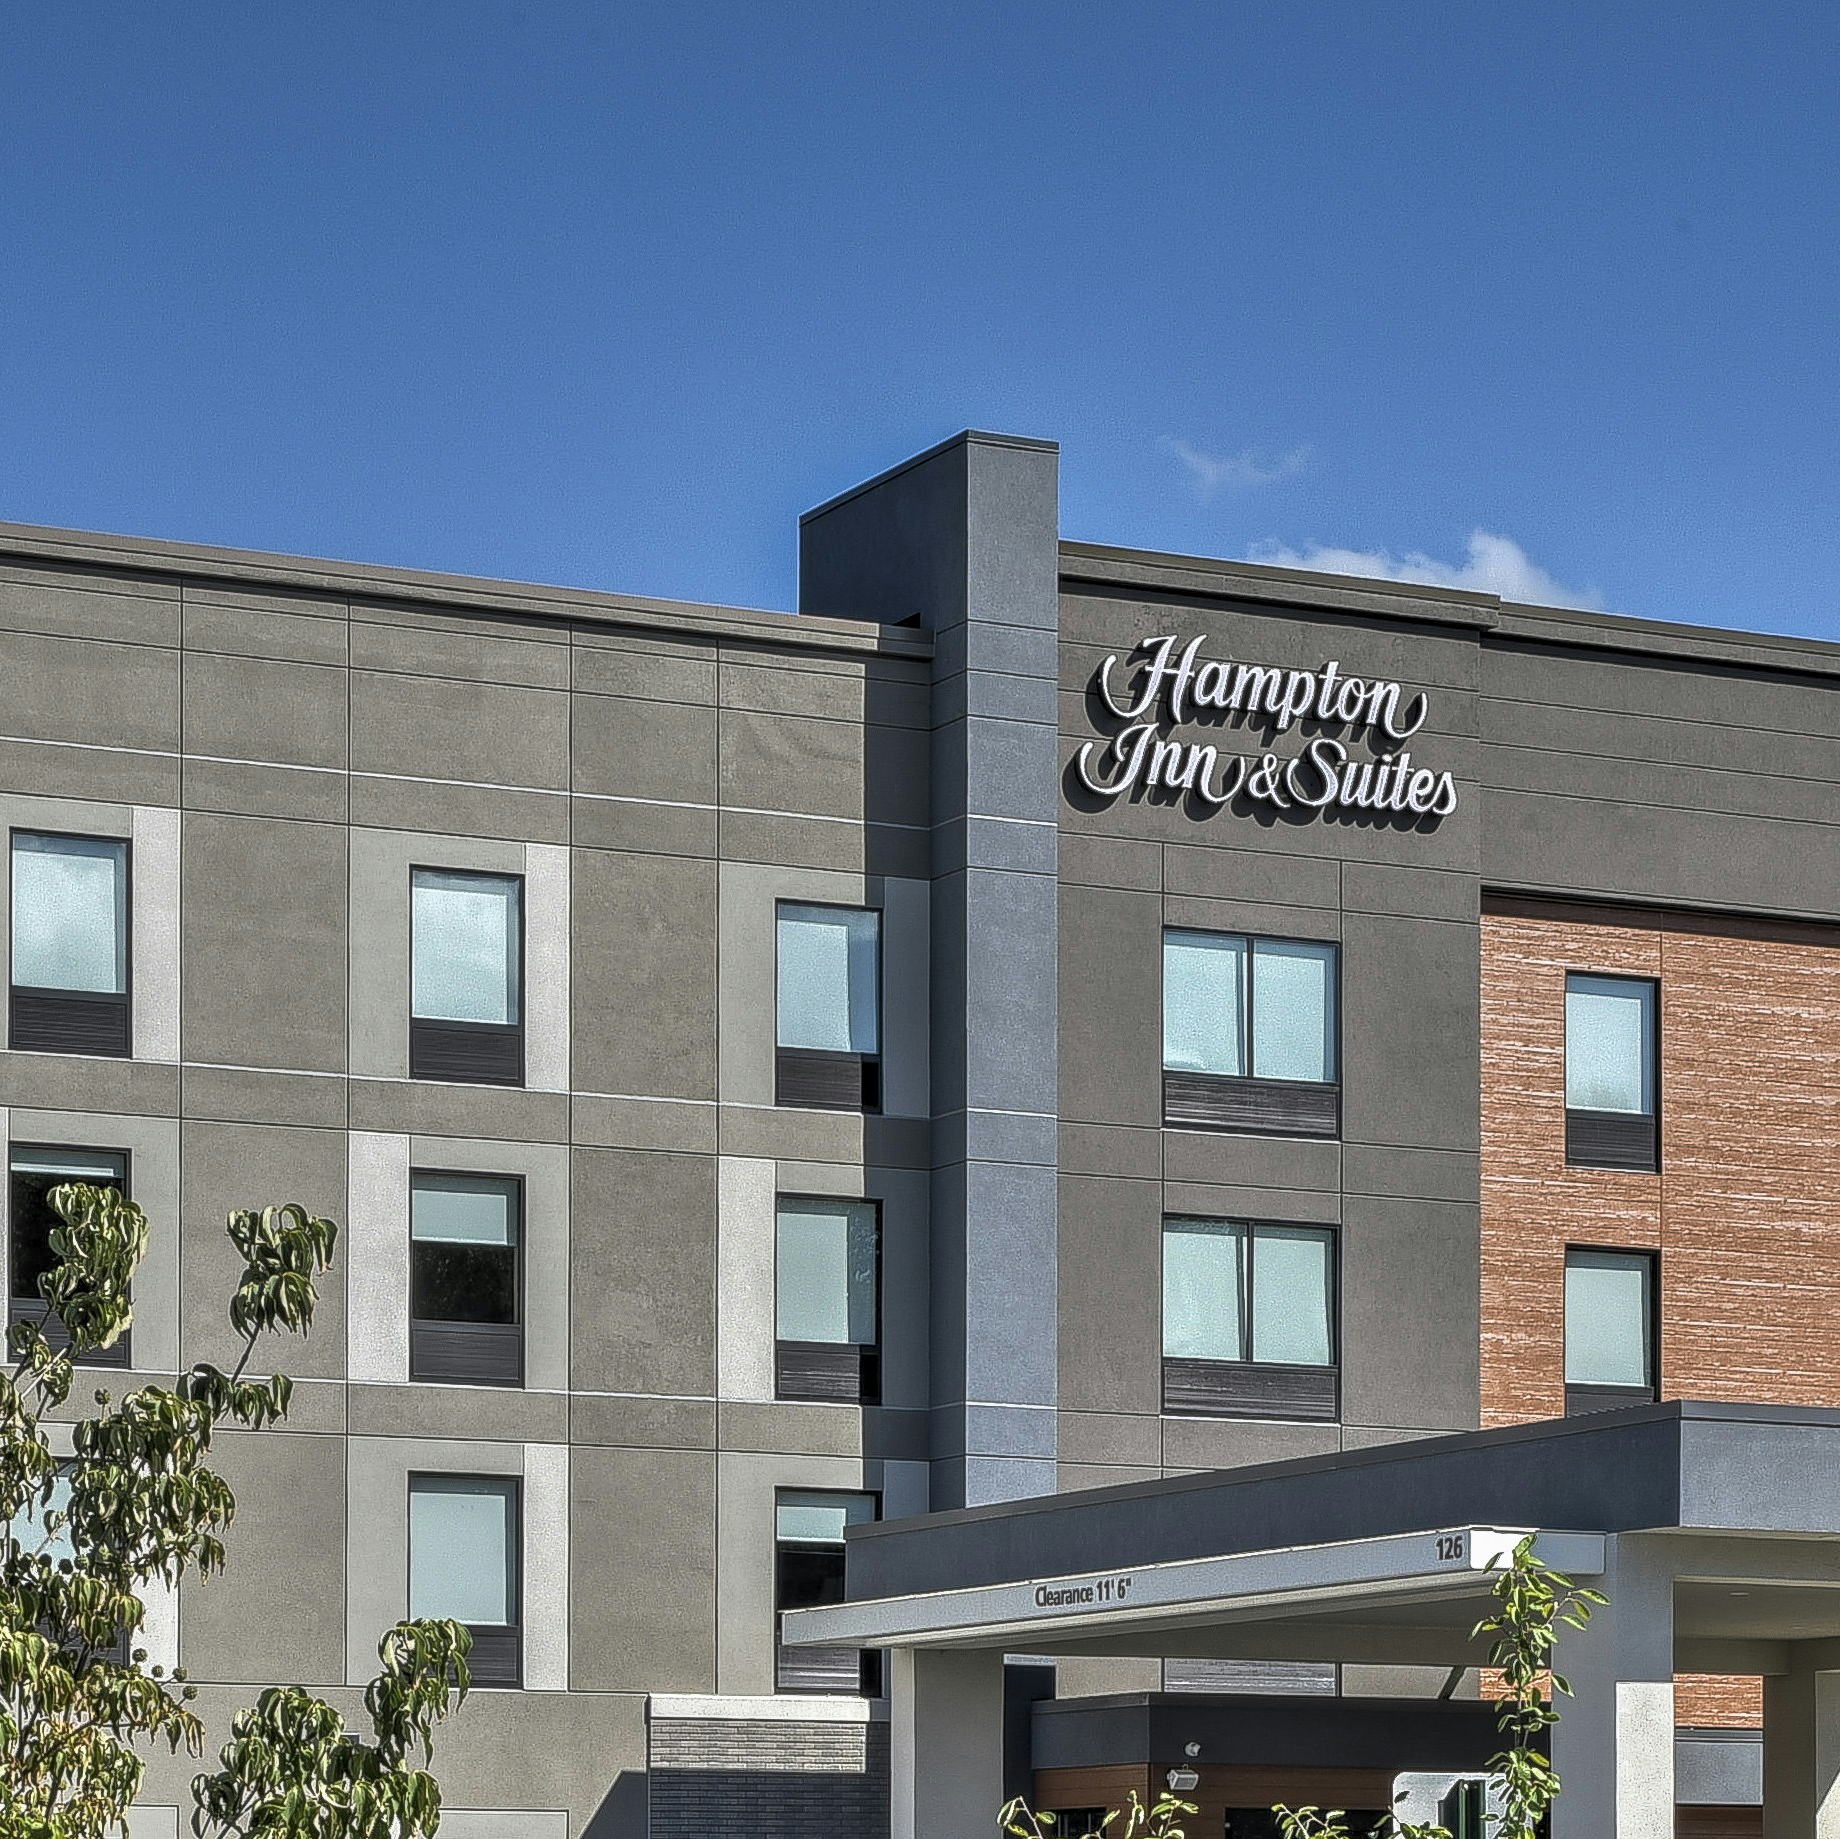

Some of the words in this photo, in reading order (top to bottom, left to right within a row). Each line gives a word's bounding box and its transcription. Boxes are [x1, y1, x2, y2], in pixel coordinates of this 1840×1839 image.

[1102, 634, 1427, 738] Hampton
[1080, 722, 1245, 802] Inn
[1248, 753, 1291, 808] &
[1286, 739, 1457, 815] Suites
[1435, 1535, 1463, 1560] 126
[1035, 1585, 1093, 1607] Clearance
